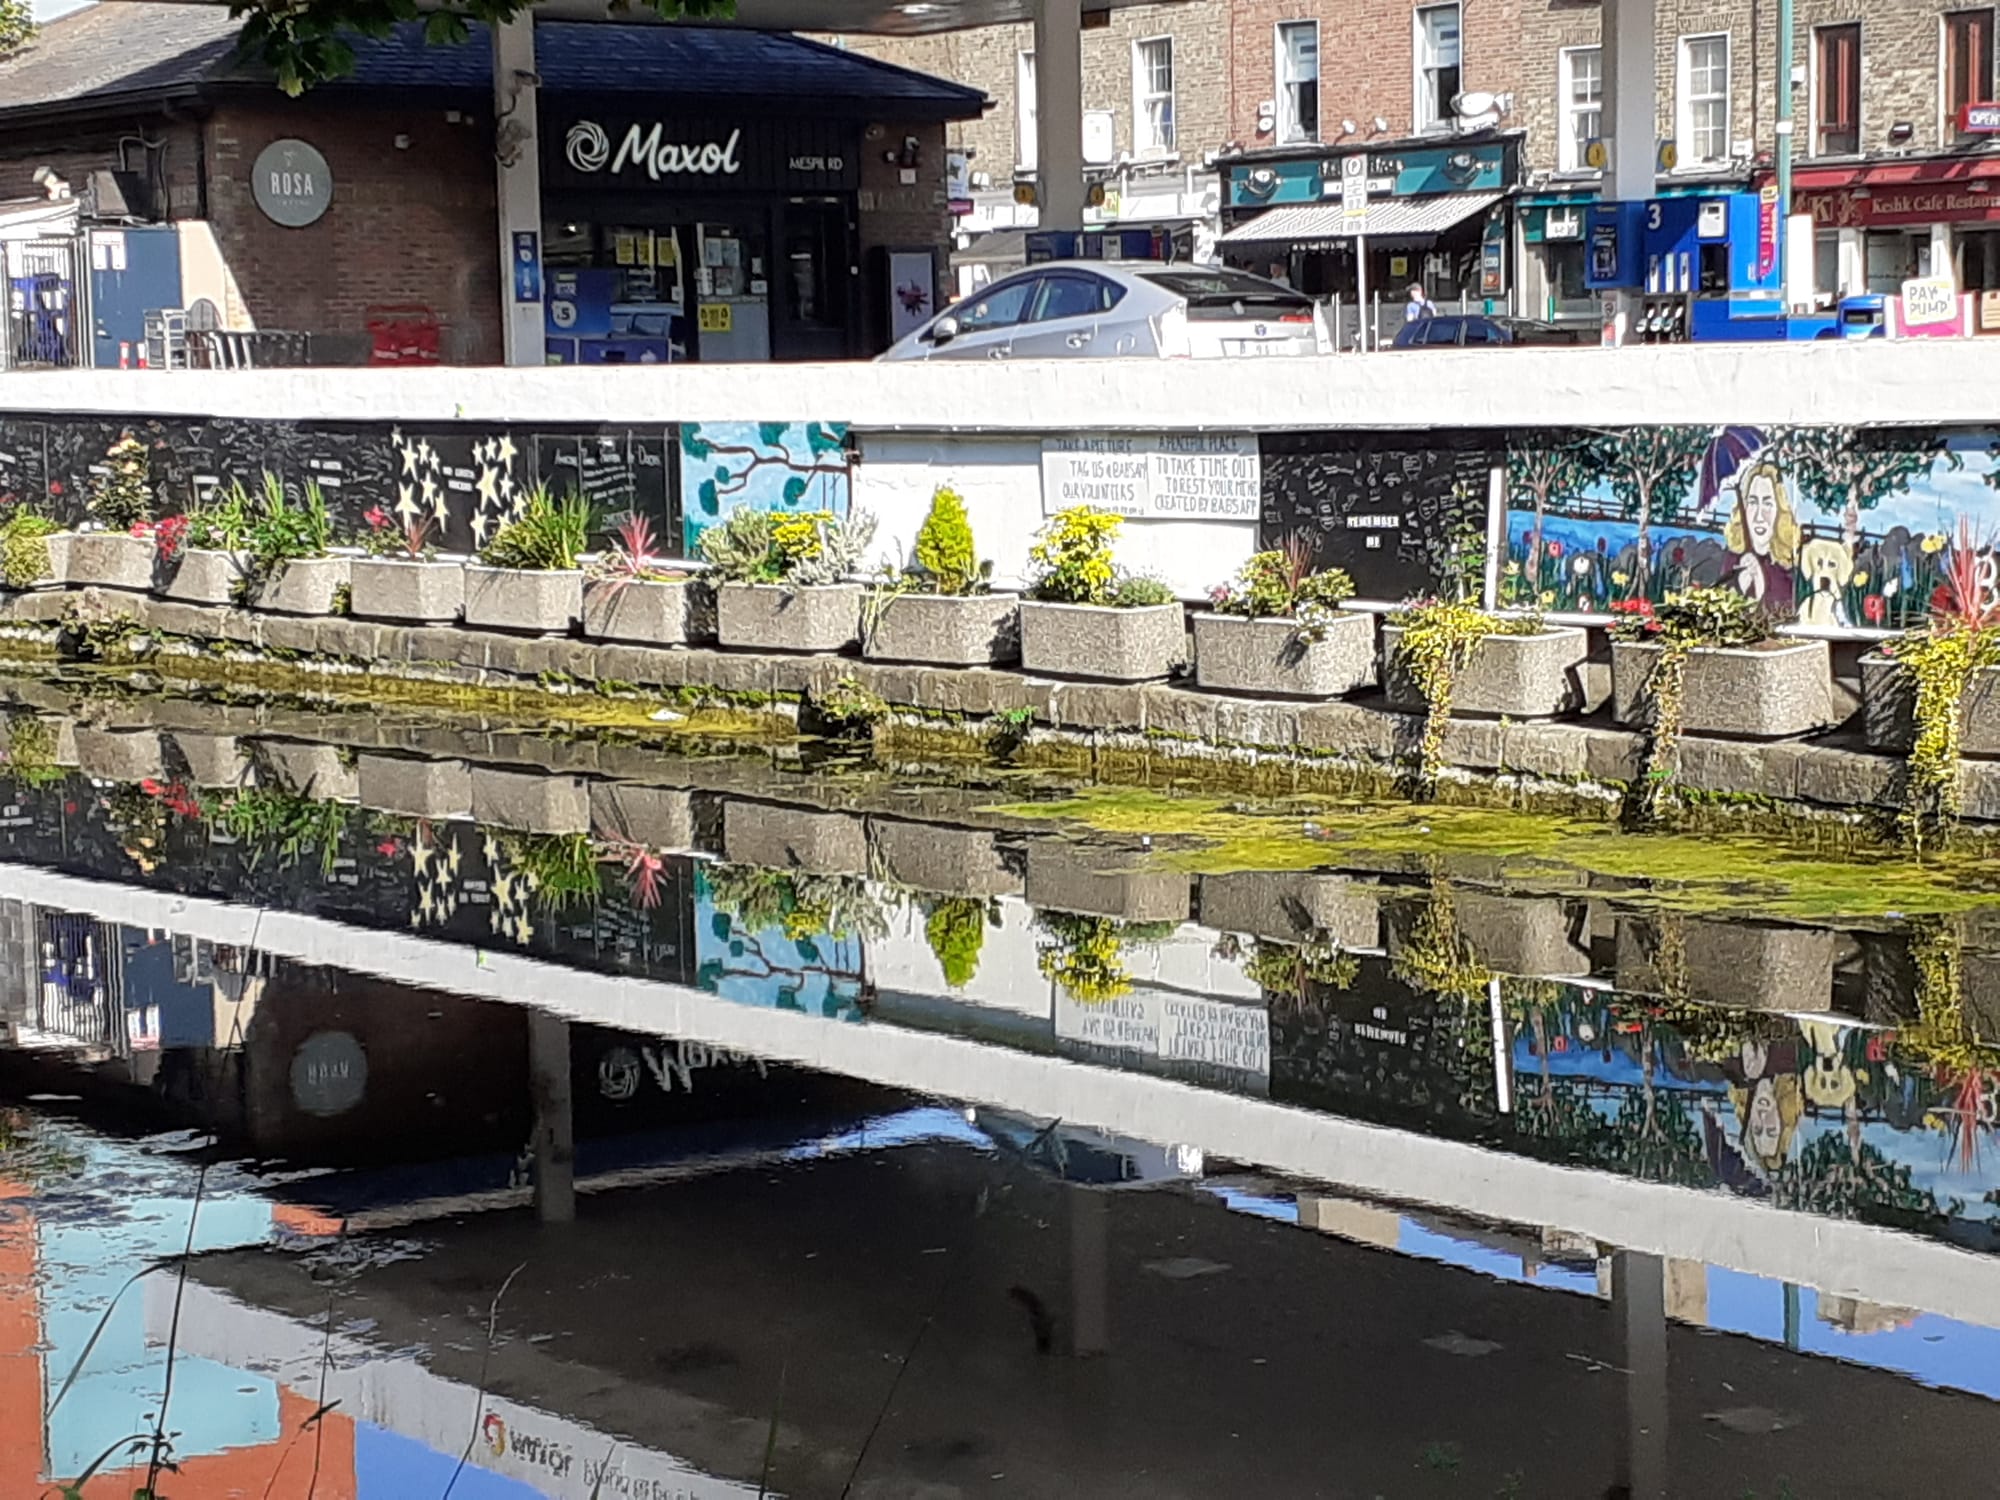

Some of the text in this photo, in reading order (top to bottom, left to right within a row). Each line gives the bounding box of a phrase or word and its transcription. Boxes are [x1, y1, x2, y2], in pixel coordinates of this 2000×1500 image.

[1968, 108, 2000, 126] OPEN
[611, 122, 741, 182] Maxol
[271, 172, 314, 196] ROSA
[1914, 195, 1943, 211] Cafe
[1648, 203, 1661, 229] 3
[1069, 460, 1090, 477] TAG
[1155, 456, 1255, 479] TO TAKE TIME OUT
[1179, 477, 1206, 494] REST
[1208, 479, 1233, 496] YOUR
